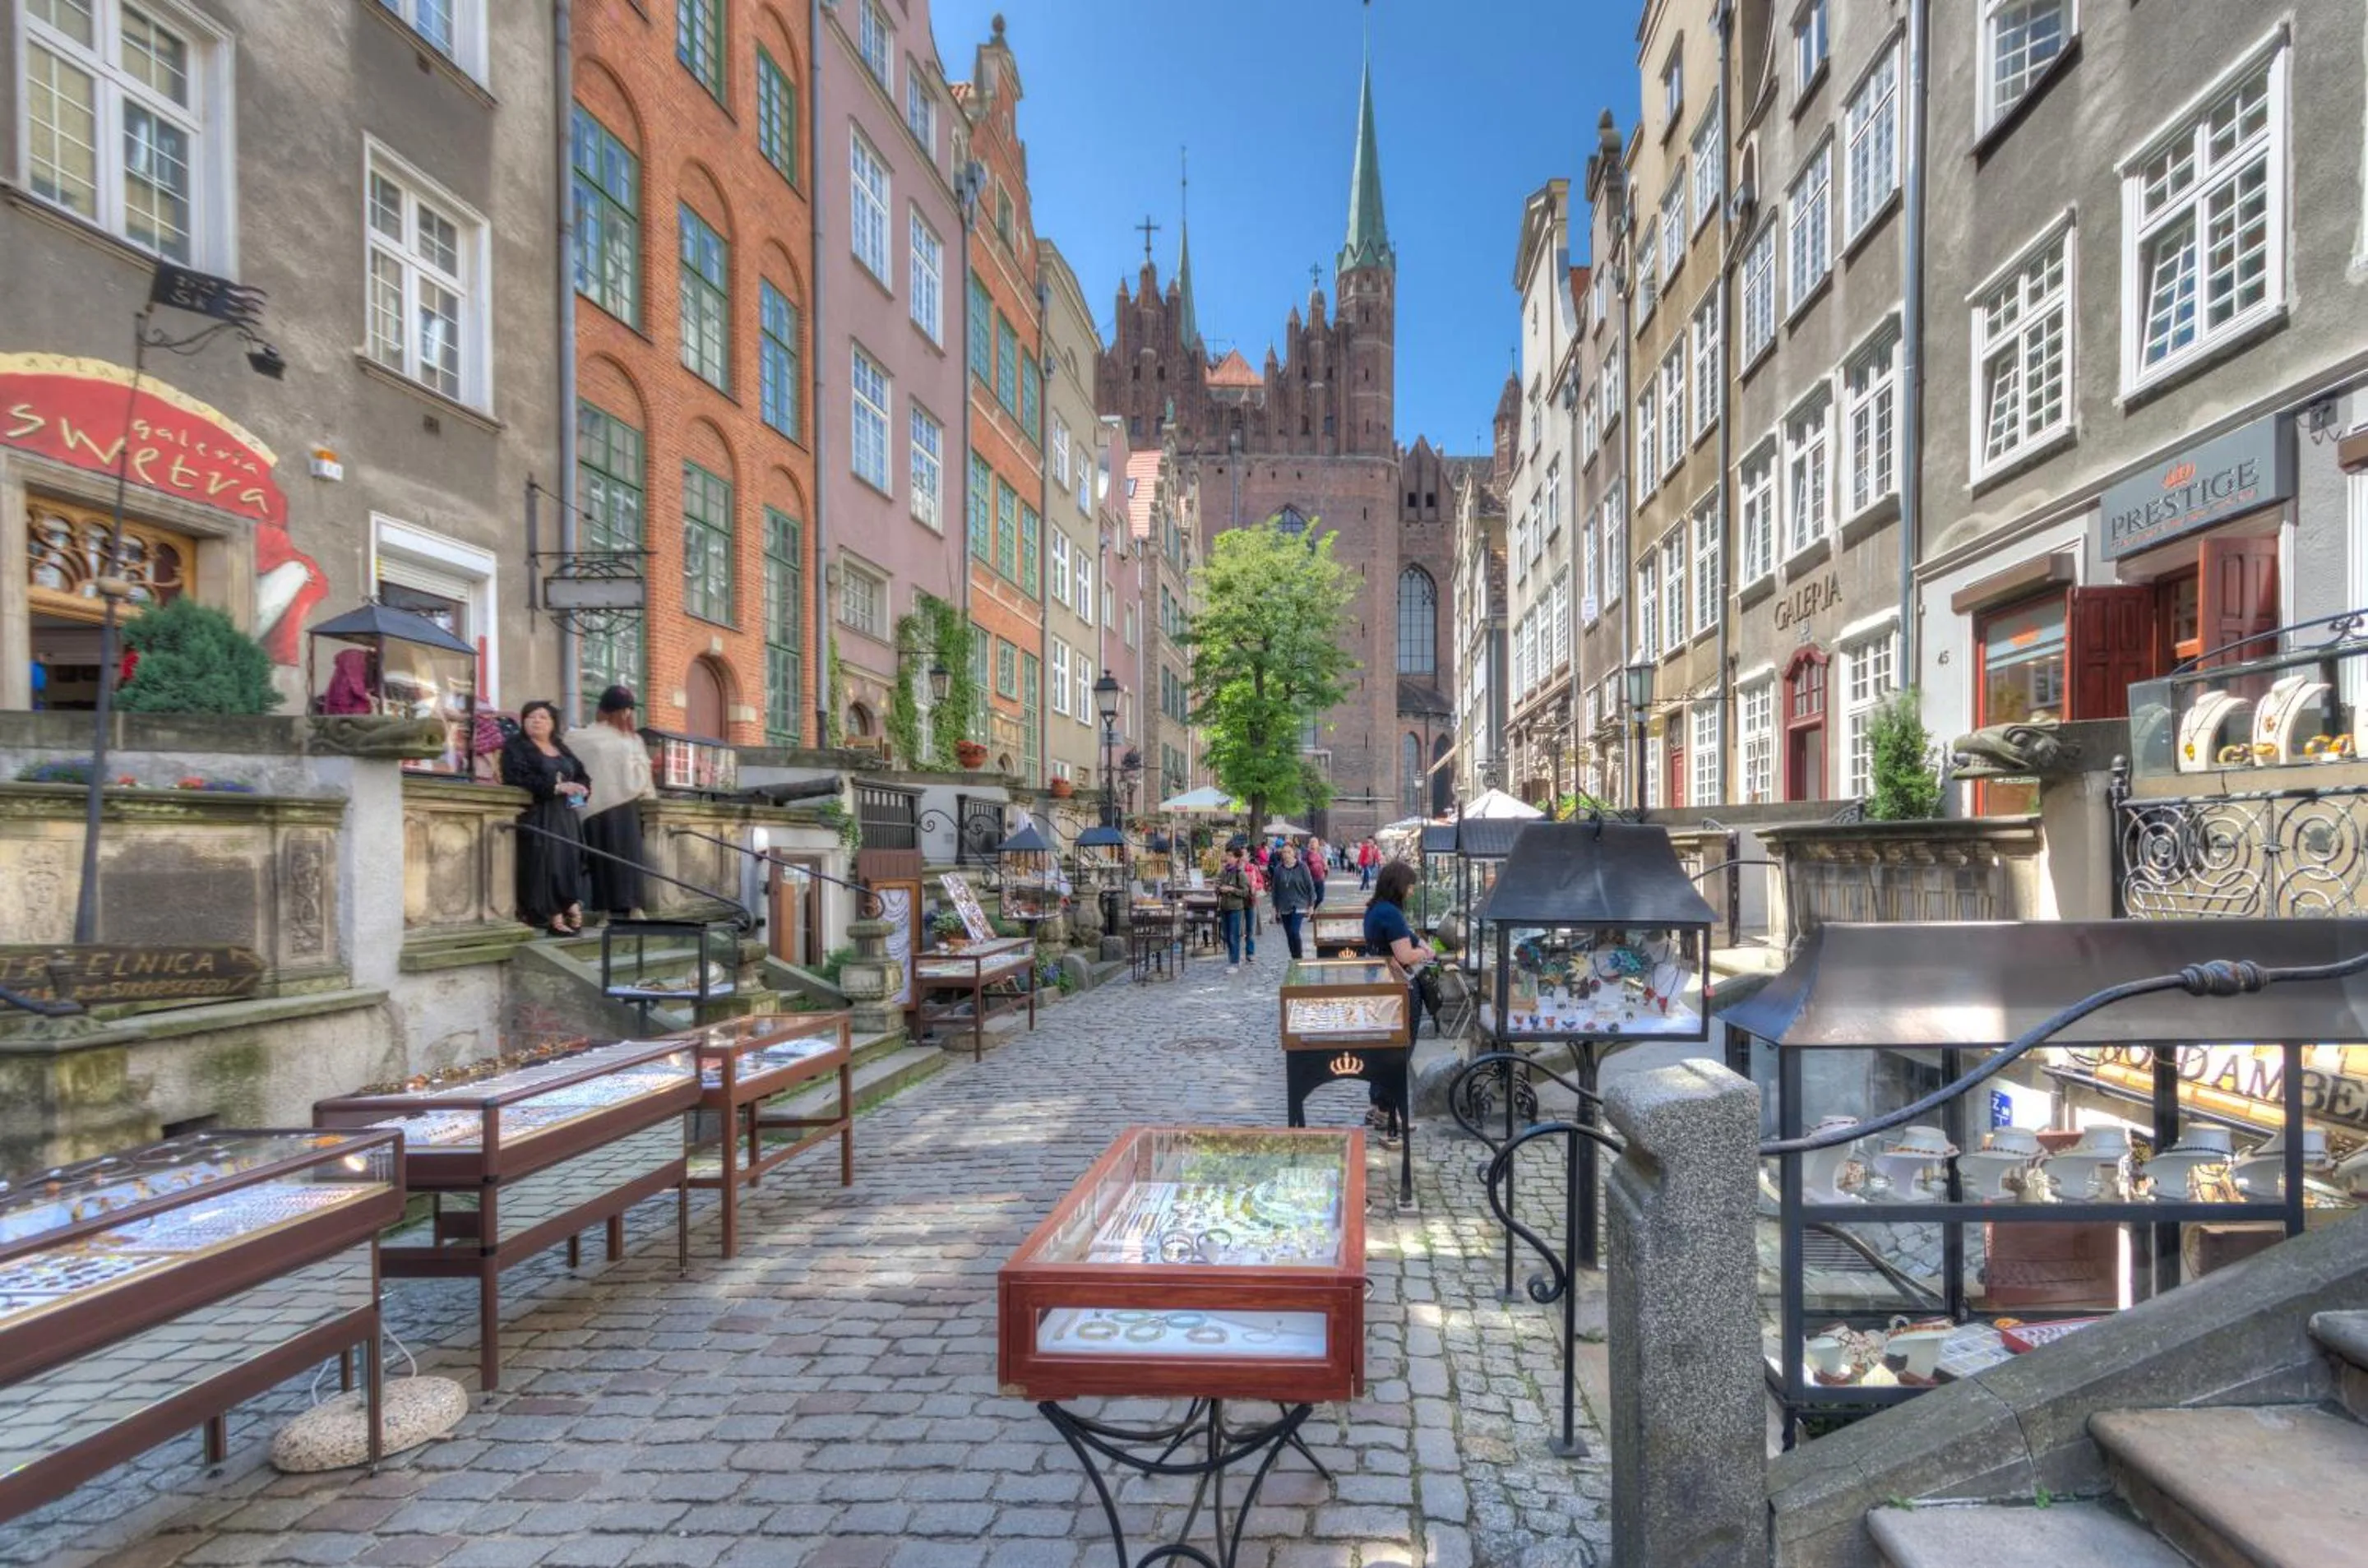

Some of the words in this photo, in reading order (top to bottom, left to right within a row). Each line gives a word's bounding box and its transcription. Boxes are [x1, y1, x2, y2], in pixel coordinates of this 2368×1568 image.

[2111, 457, 2261, 542] PRESTIGE
[1774, 571, 1843, 631] GALERIA
[0, 951, 215, 978] TRELNICA
[2211, 1054, 2368, 1124] AMBE
